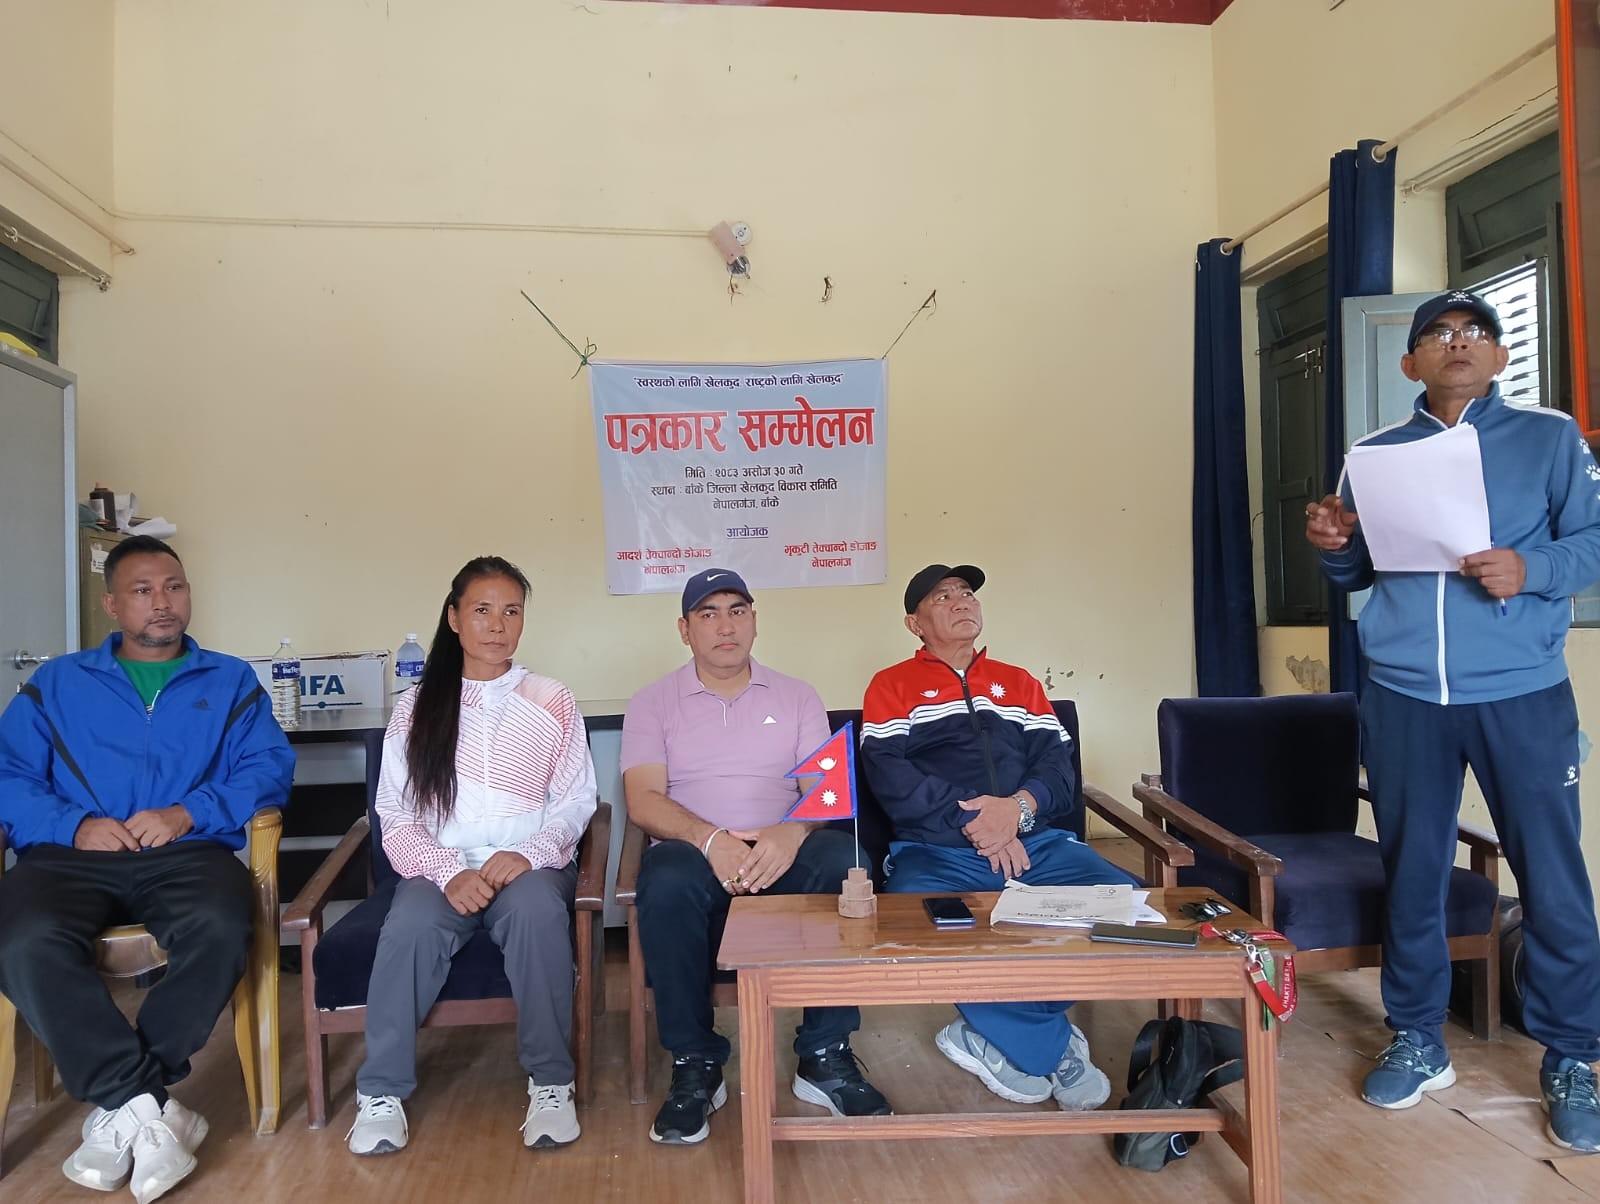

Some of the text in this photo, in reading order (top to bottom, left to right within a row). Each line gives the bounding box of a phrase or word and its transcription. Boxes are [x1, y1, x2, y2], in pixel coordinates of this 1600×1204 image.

[678, 375, 701, 387] लागि
[780, 373, 803, 386] लागि
[603, 395, 876, 454] पत्रकार सम्मेलन
[685, 466, 706, 478] मिति
[714, 468, 739, 478] २०८३
[742, 466, 771, 478] असोज
[773, 467, 786, 477] ३०
[789, 464, 803, 475] गते
[651, 485, 676, 497] स्थान
[707, 481, 737, 494] जिल्ला
[777, 480, 807, 492] विकास
[809, 478, 838, 491] समिति
[726, 525, 769, 538] आयोजक
